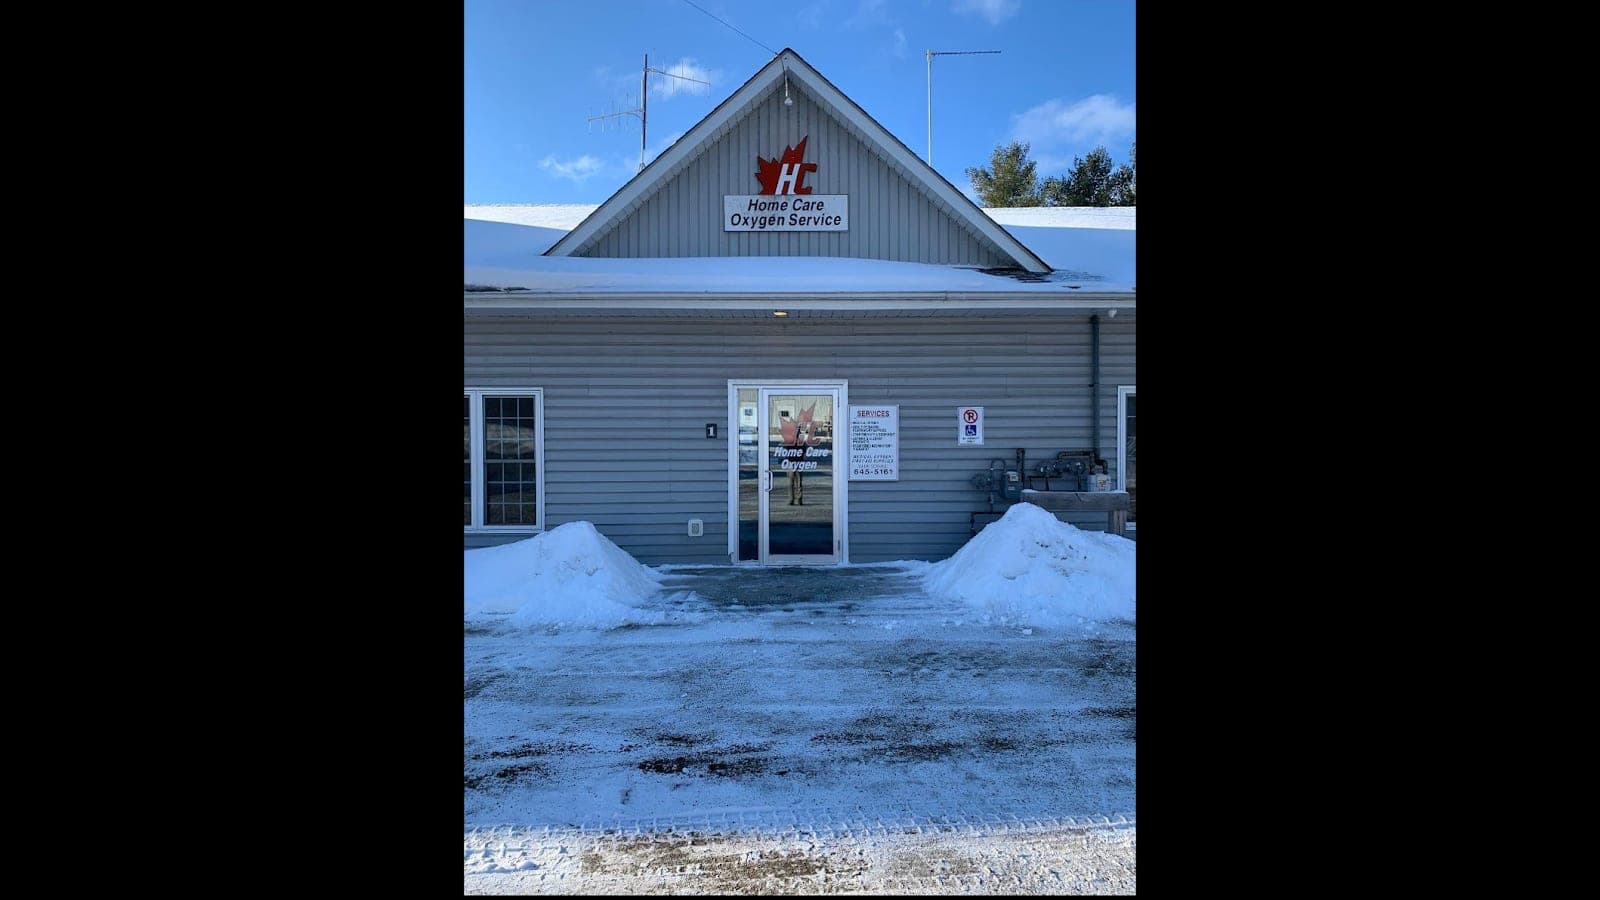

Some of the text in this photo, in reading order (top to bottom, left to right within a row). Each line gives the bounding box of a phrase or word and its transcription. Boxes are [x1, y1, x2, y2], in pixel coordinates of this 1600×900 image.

[775, 163, 817, 195] HC
[748, 199, 824, 212] Home Care
[731, 213, 842, 229] Oxygen Service
[774, 446, 829, 457] Home Care
[781, 459, 817, 472] Oxygen
